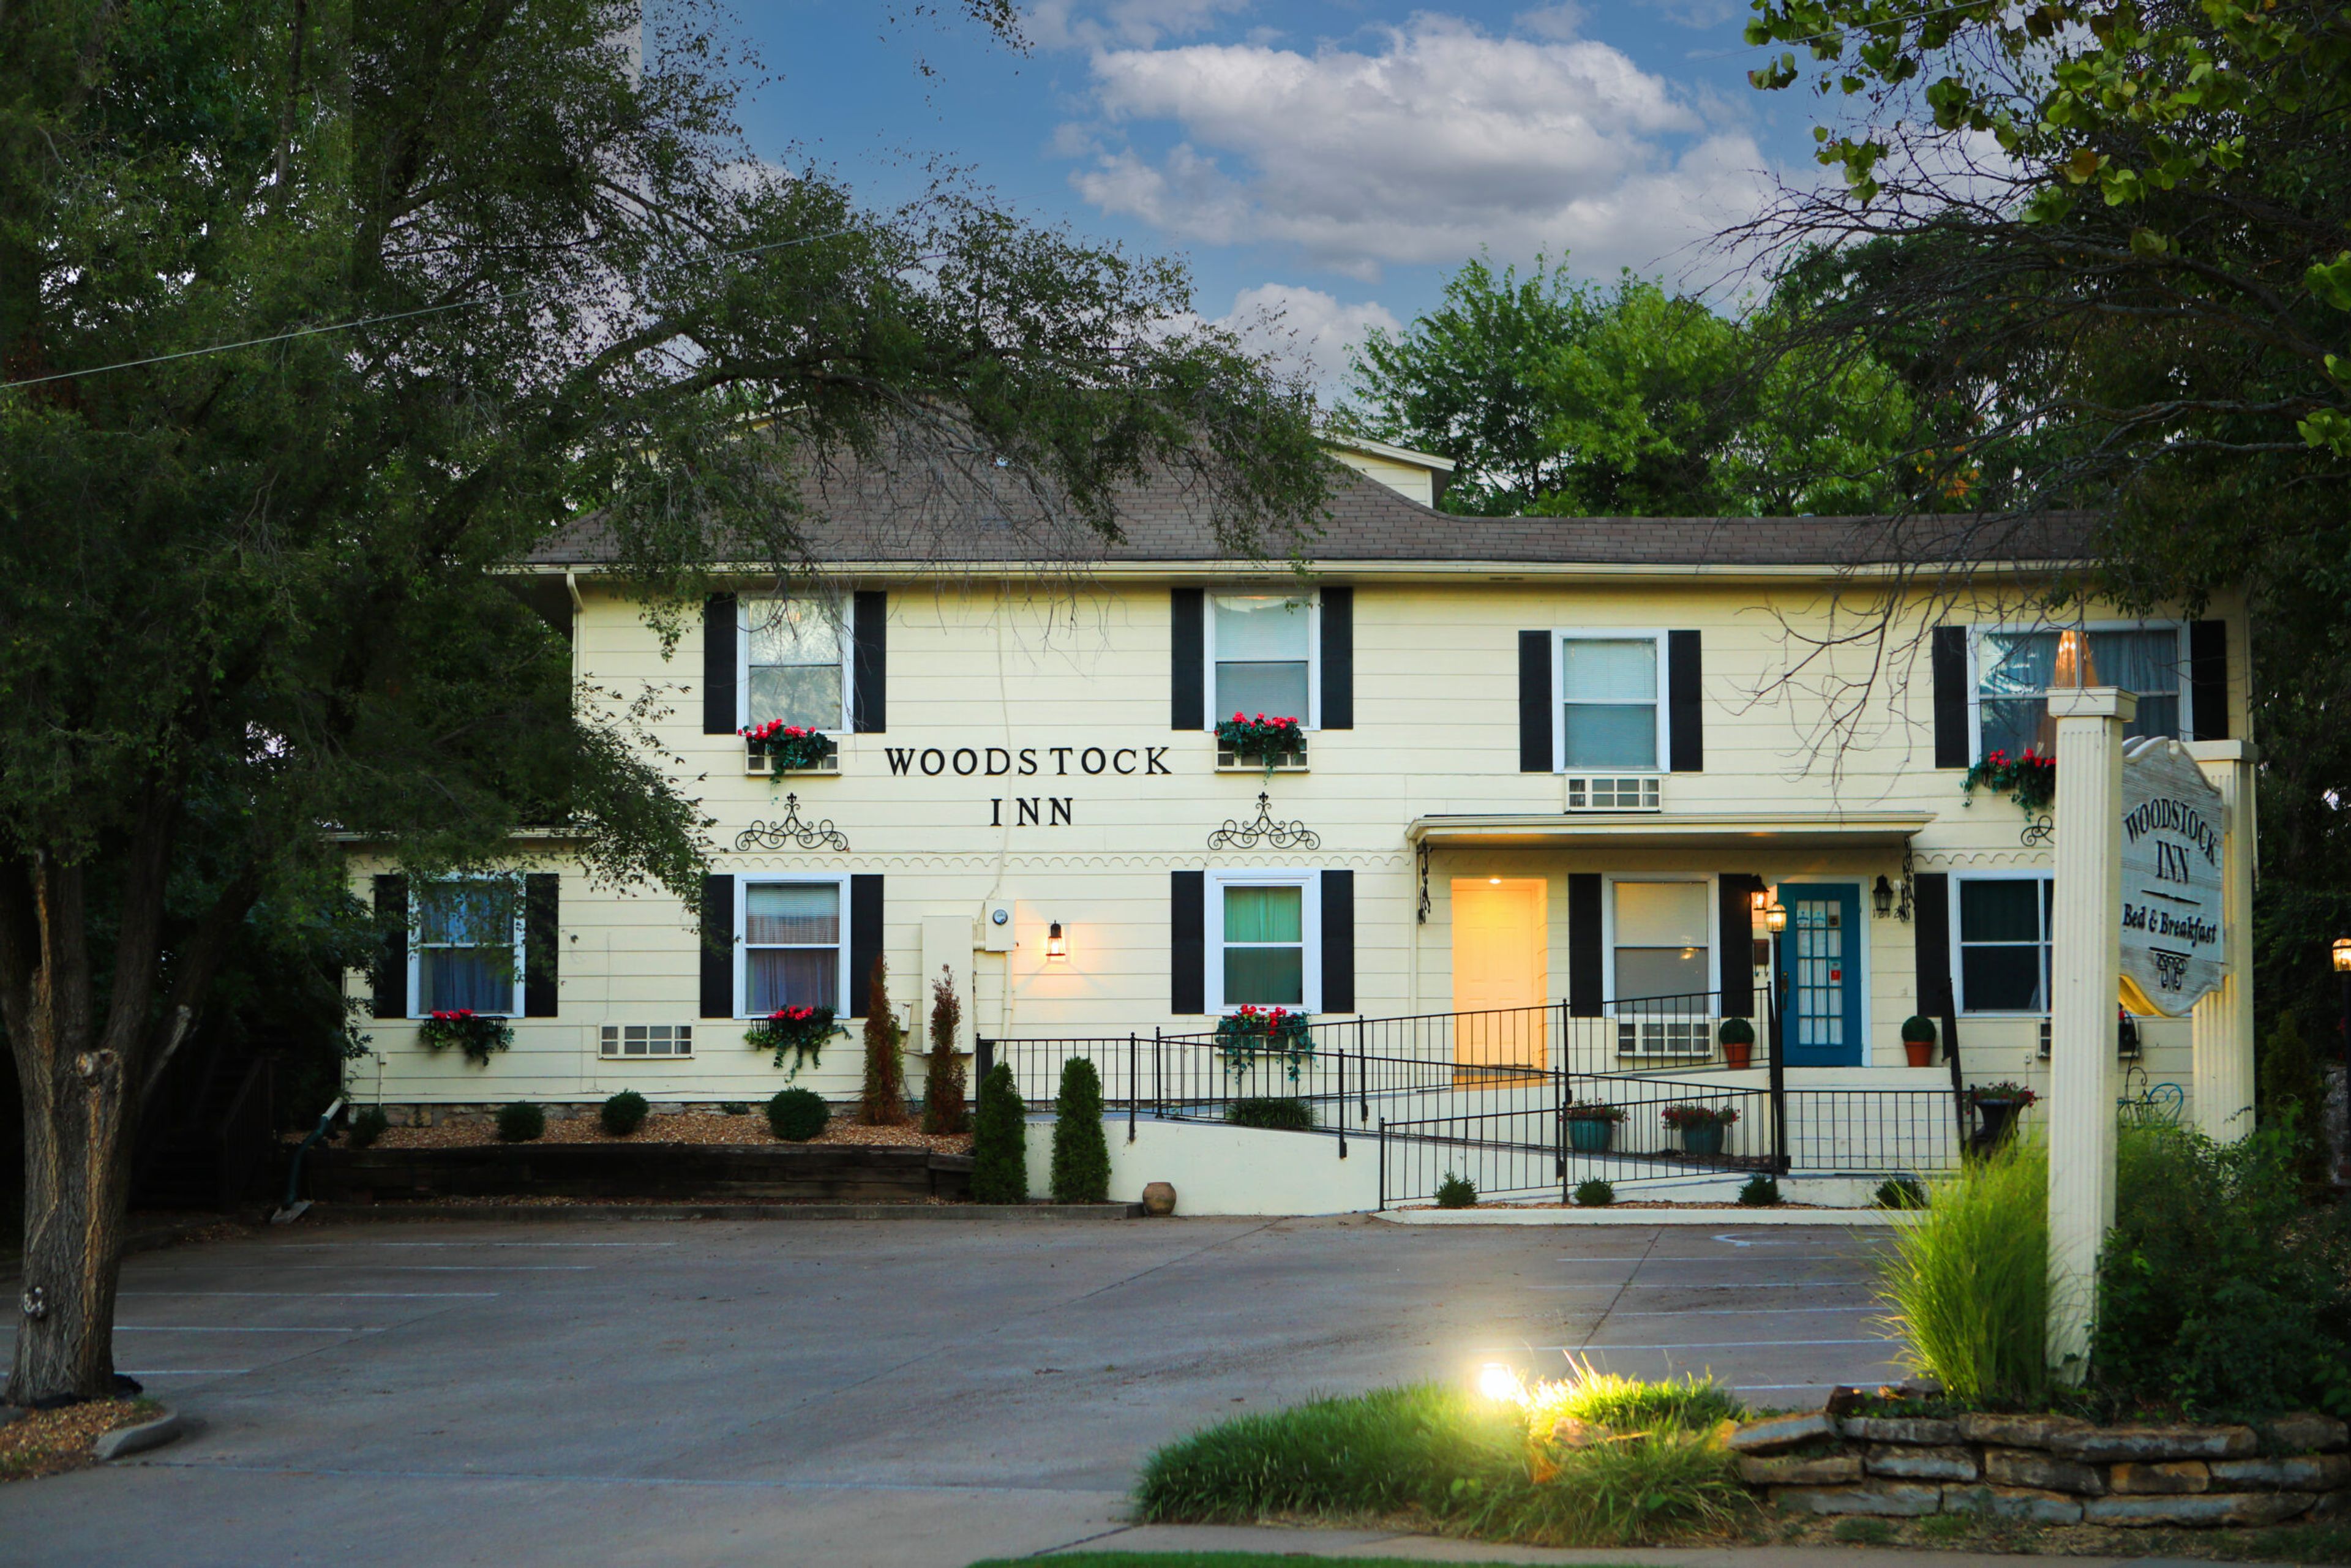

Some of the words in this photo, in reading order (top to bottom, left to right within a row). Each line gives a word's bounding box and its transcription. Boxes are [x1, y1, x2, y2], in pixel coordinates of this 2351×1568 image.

[885, 747, 1172, 776] WOODSTOCK
[990, 797, 1073, 826] INN
[2124, 798, 2218, 866] WOODSTOCK
[2155, 840, 2189, 883] INN
[2123, 903, 2146, 929] Bed
[2149, 909, 2157, 932] &
[2159, 912, 2216, 948] Breakfast
